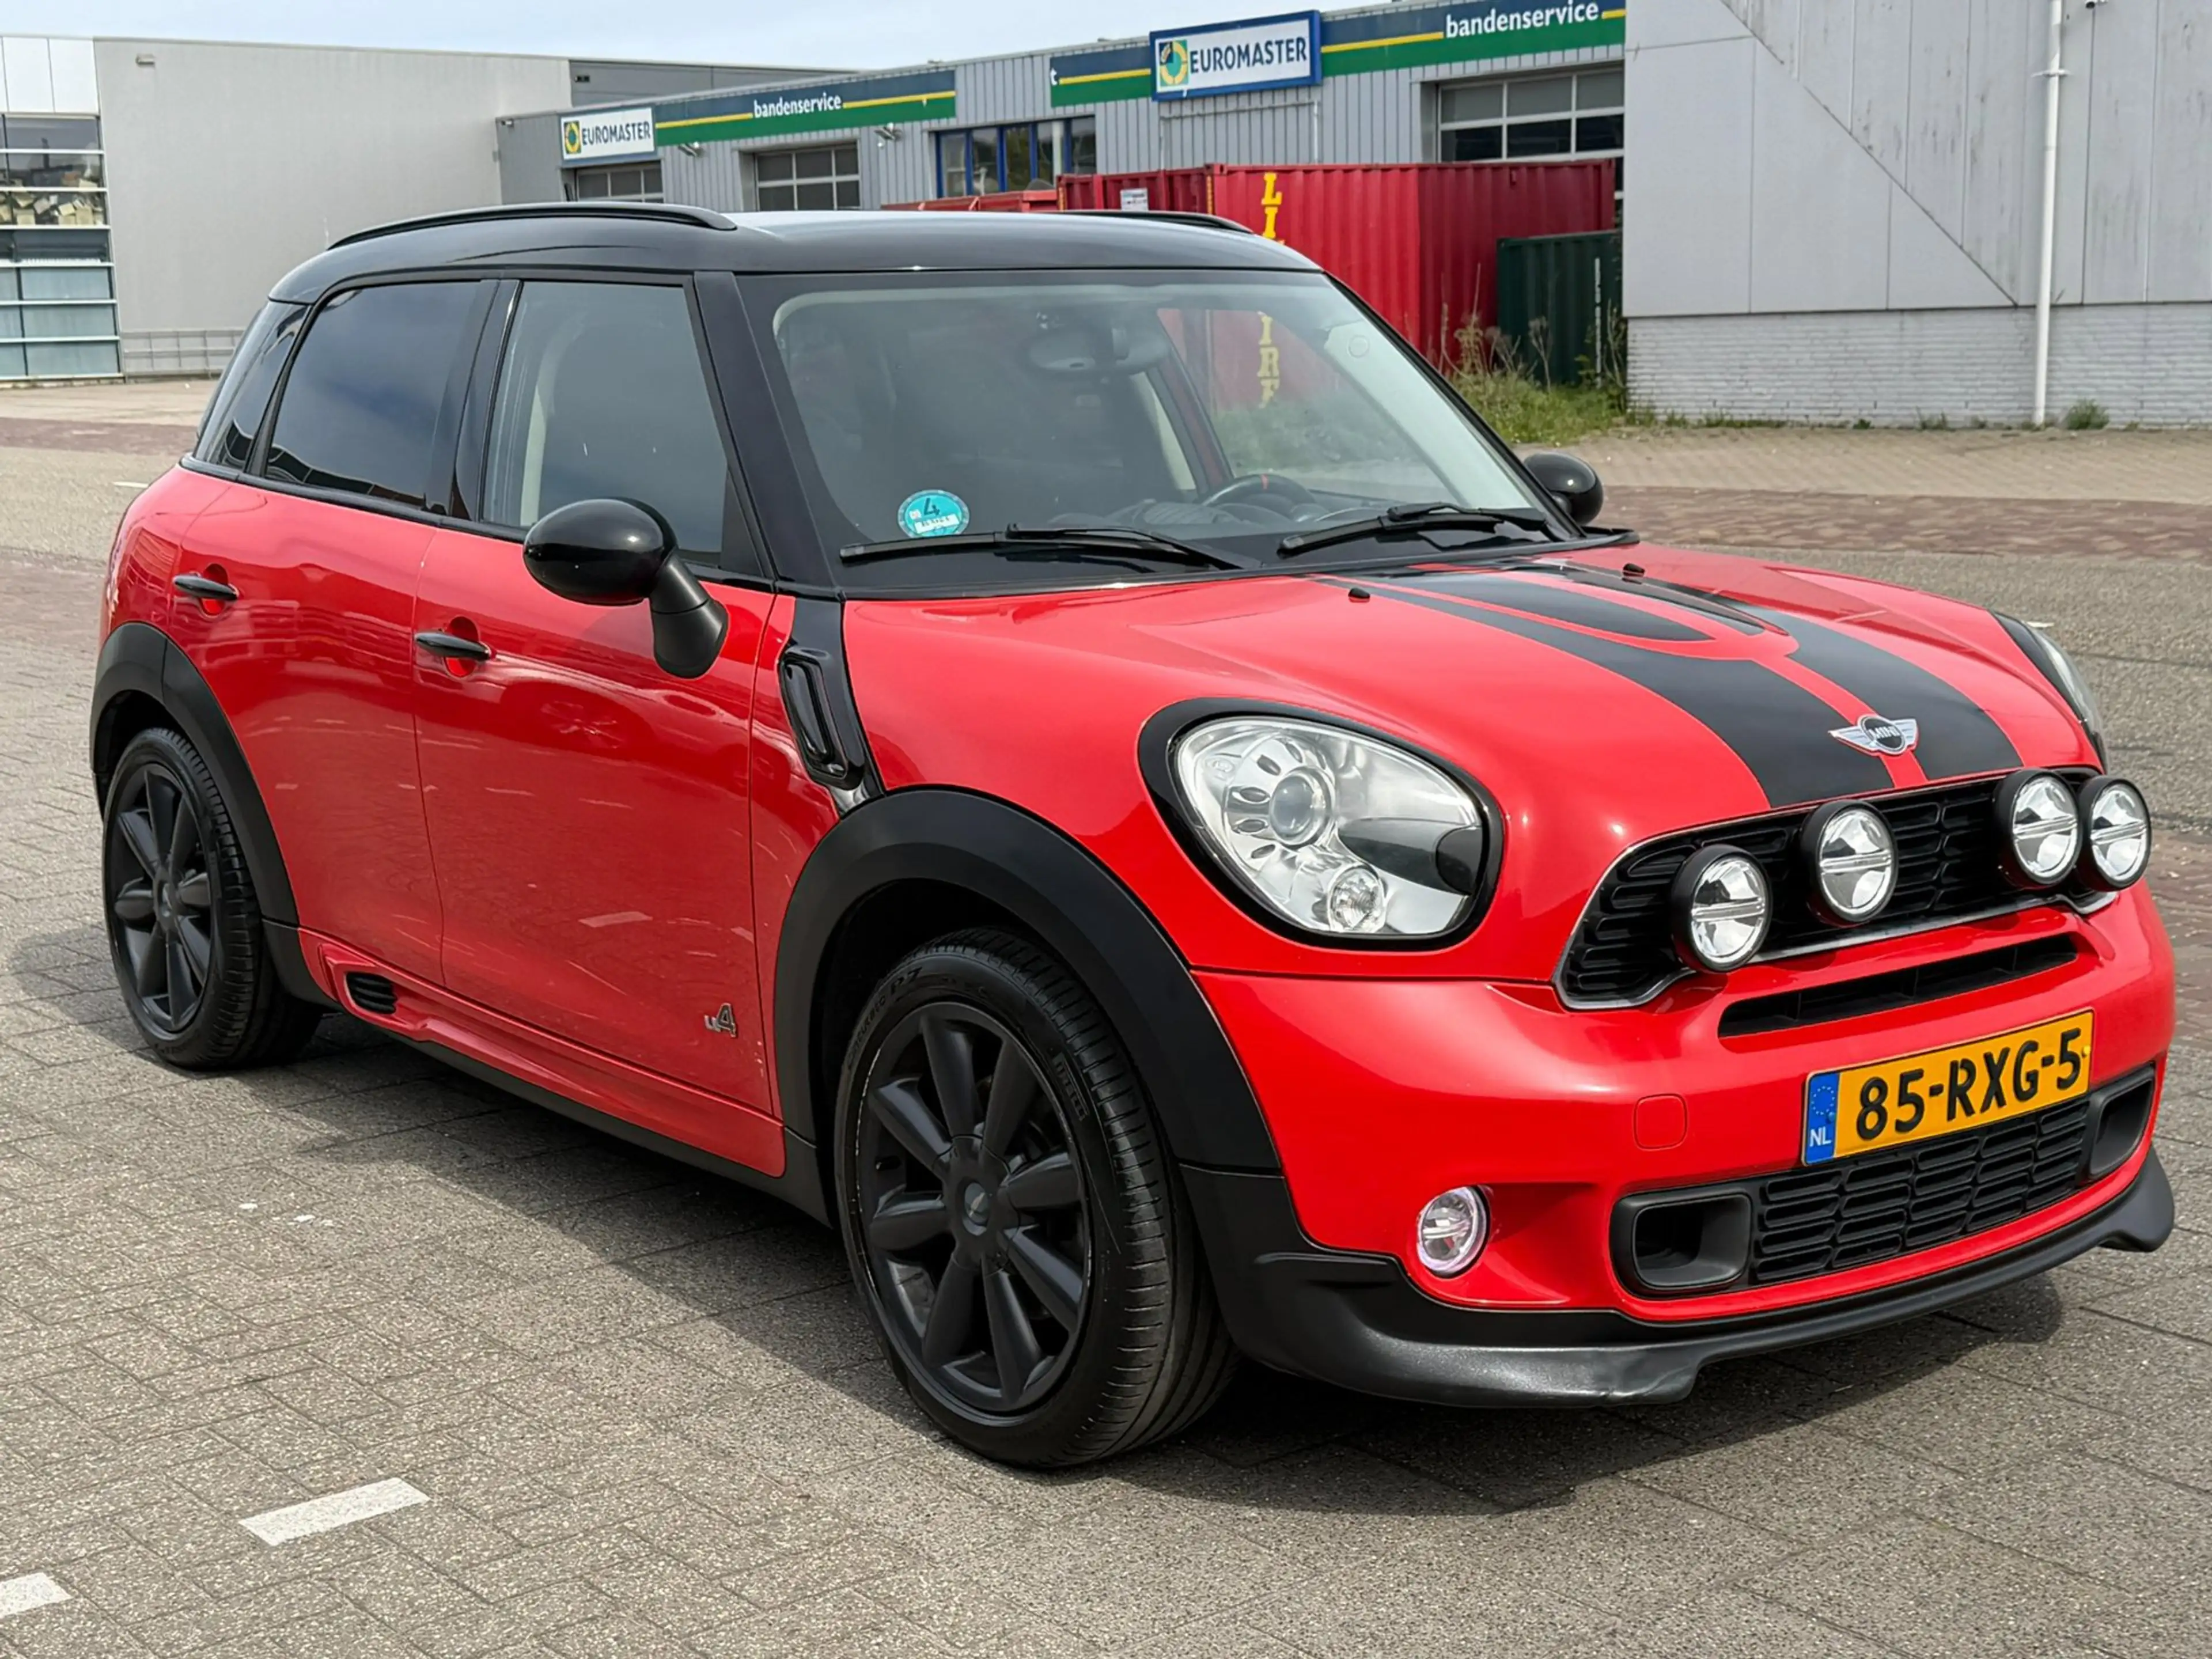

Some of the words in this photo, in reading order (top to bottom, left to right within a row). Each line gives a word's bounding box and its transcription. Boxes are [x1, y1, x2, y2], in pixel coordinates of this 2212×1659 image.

[1446, 0, 1599, 38] bandenservice
[1190, 36, 1307, 74] EUROMASTER
[753, 90, 842, 119] bandenservice
[582, 121, 651, 146] EUROMASTER
[1856, 1027, 2082, 1141] 85-RXG-5
[1809, 1126, 1832, 1147] NL
